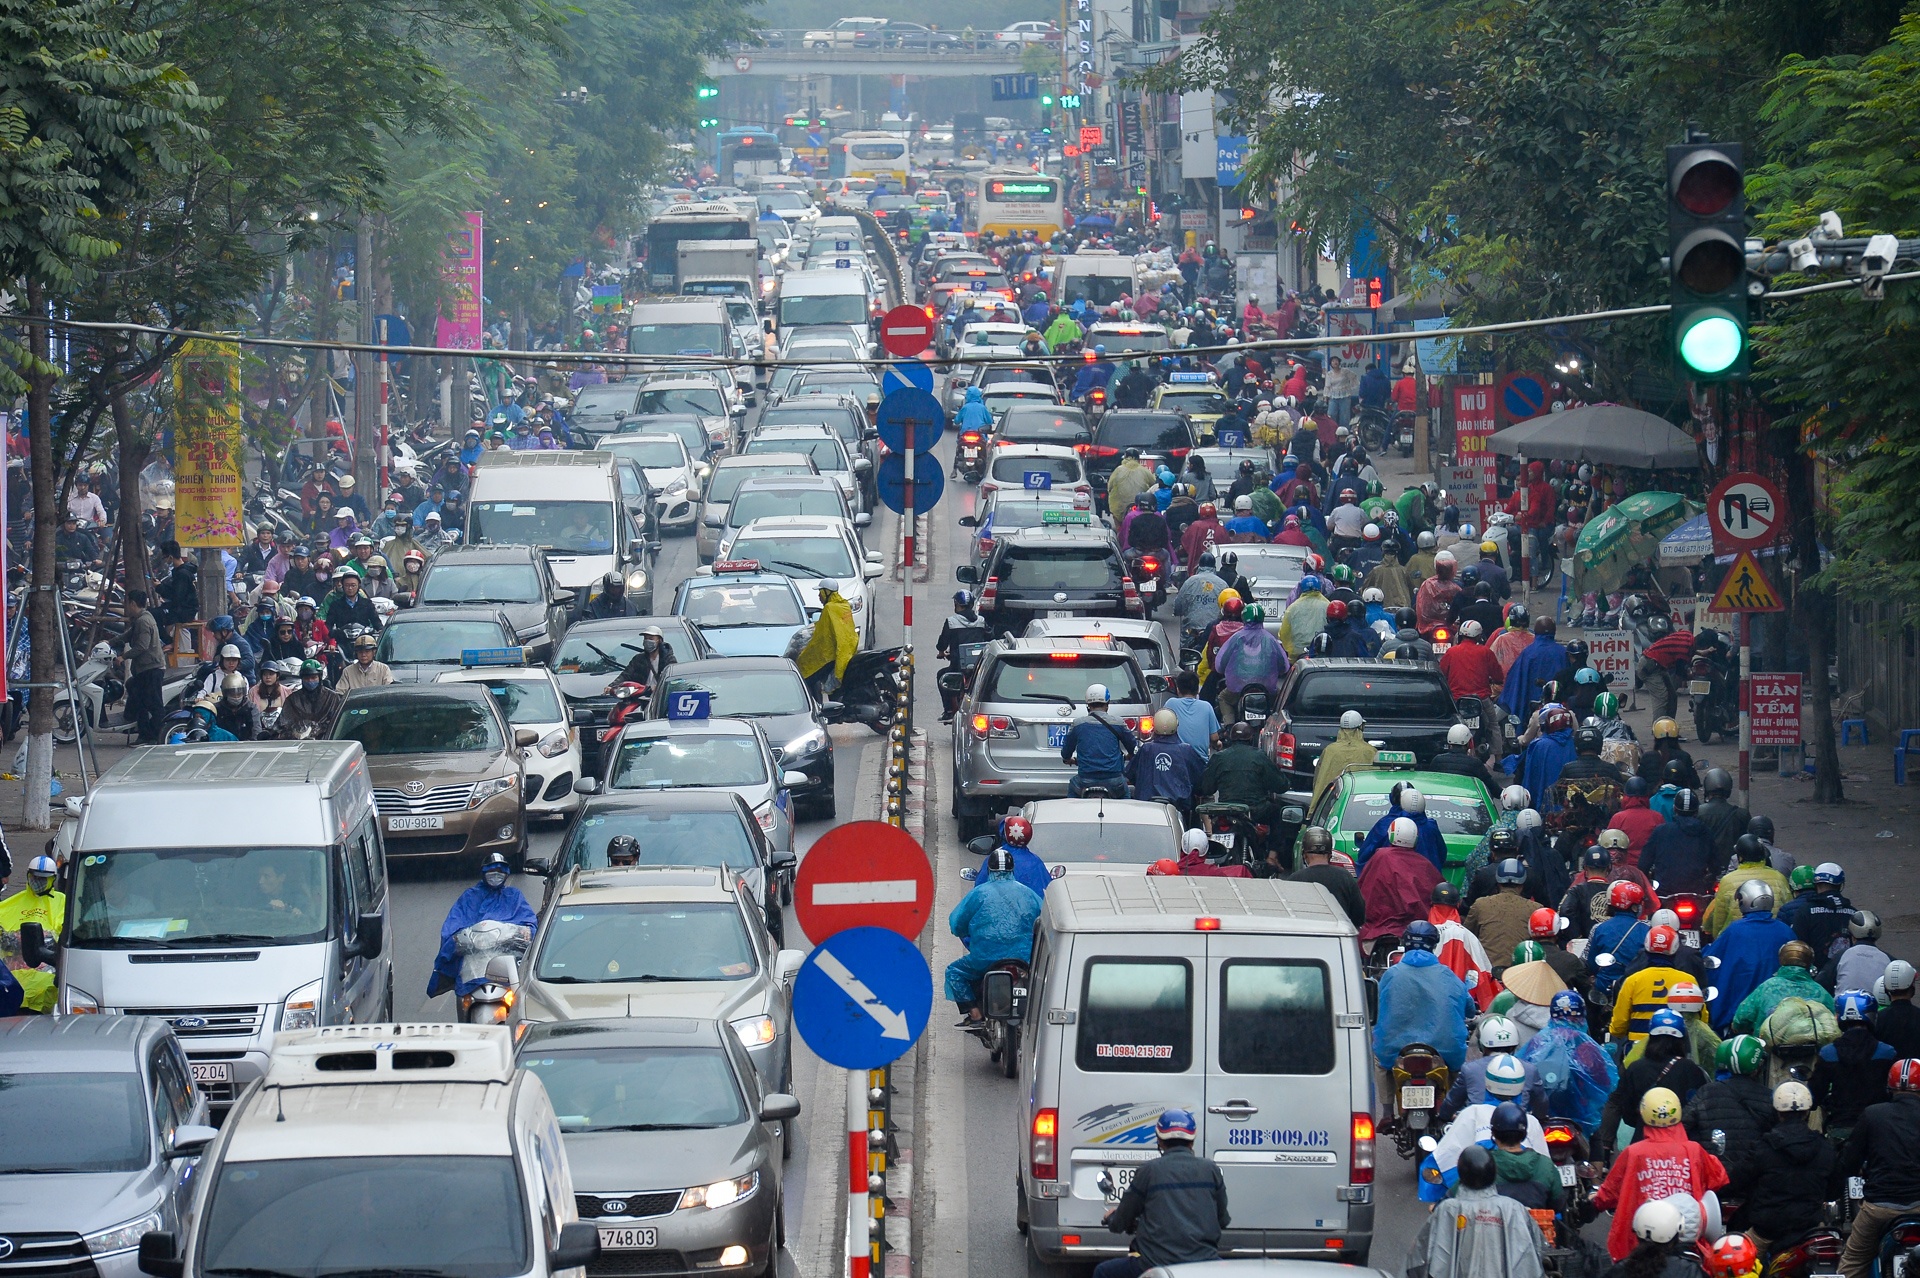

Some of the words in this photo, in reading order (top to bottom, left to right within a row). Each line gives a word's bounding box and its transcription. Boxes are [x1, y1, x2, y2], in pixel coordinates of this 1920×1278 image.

[1219, 149, 1239, 158] Pet
[1461, 391, 1487, 411] MŨ
[1456, 419, 1472, 431] BẢO
[1474, 416, 1495, 430] HIỂM
[1224, 432, 1238, 446] G7
[1458, 453, 1473, 467] LẮP
[1474, 456, 1496, 467] KÍNH
[1029, 473, 1045, 488] G7
[1452, 470, 1474, 480] MŨ
[1590, 637, 1630, 654] HÀN
[1593, 654, 1629, 671] YẾM
[1755, 682, 1798, 696] HÀN
[677, 694, 700, 717] G7
[1753, 698, 1795, 714] YẾM
[1752, 718, 1760, 727] XE
[391, 817, 438, 829] 30V-9812
[1810, 906, 1834, 915] URBAN
[179, 1018, 200, 1027] Ford
[1113, 1046, 1135, 1057] 0984
[1137, 1046, 1154, 1057] 215
[1155, 1046, 1172, 1058] 287
[1750, 1047, 1762, 1065] Grab
[1101, 1120, 1124, 1133] Legacy
[1123, 1117, 1132, 1125] of
[1131, 1105, 1166, 1123] Innovation
[1101, 1151, 1142, 1160] Mercedes
